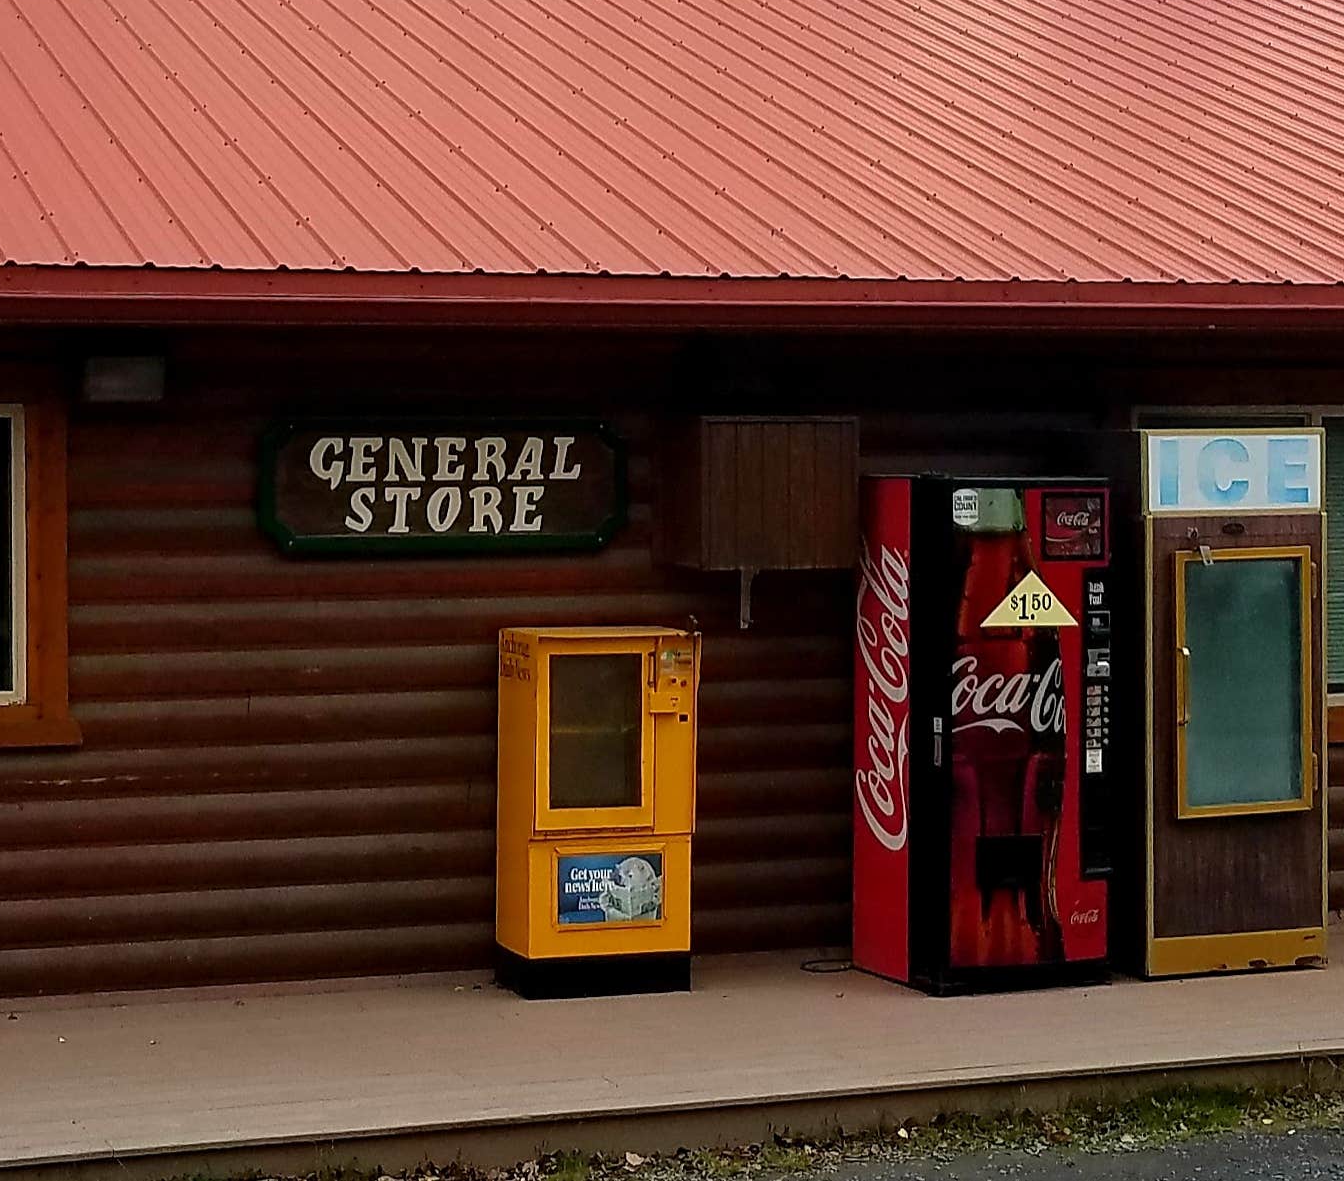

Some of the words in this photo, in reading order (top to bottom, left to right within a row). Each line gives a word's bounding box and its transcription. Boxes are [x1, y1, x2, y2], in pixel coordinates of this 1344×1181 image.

[309, 436, 581, 491] GENERAL
[1159, 437, 1310, 506] ICE
[344, 486, 545, 534] STORE
[1010, 593, 1052, 621] $1.50
[856, 535, 908, 851] Coca-Cola
[565, 880, 590, 894] news
[570, 868, 587, 881] Get
[587, 867, 613, 882] your
